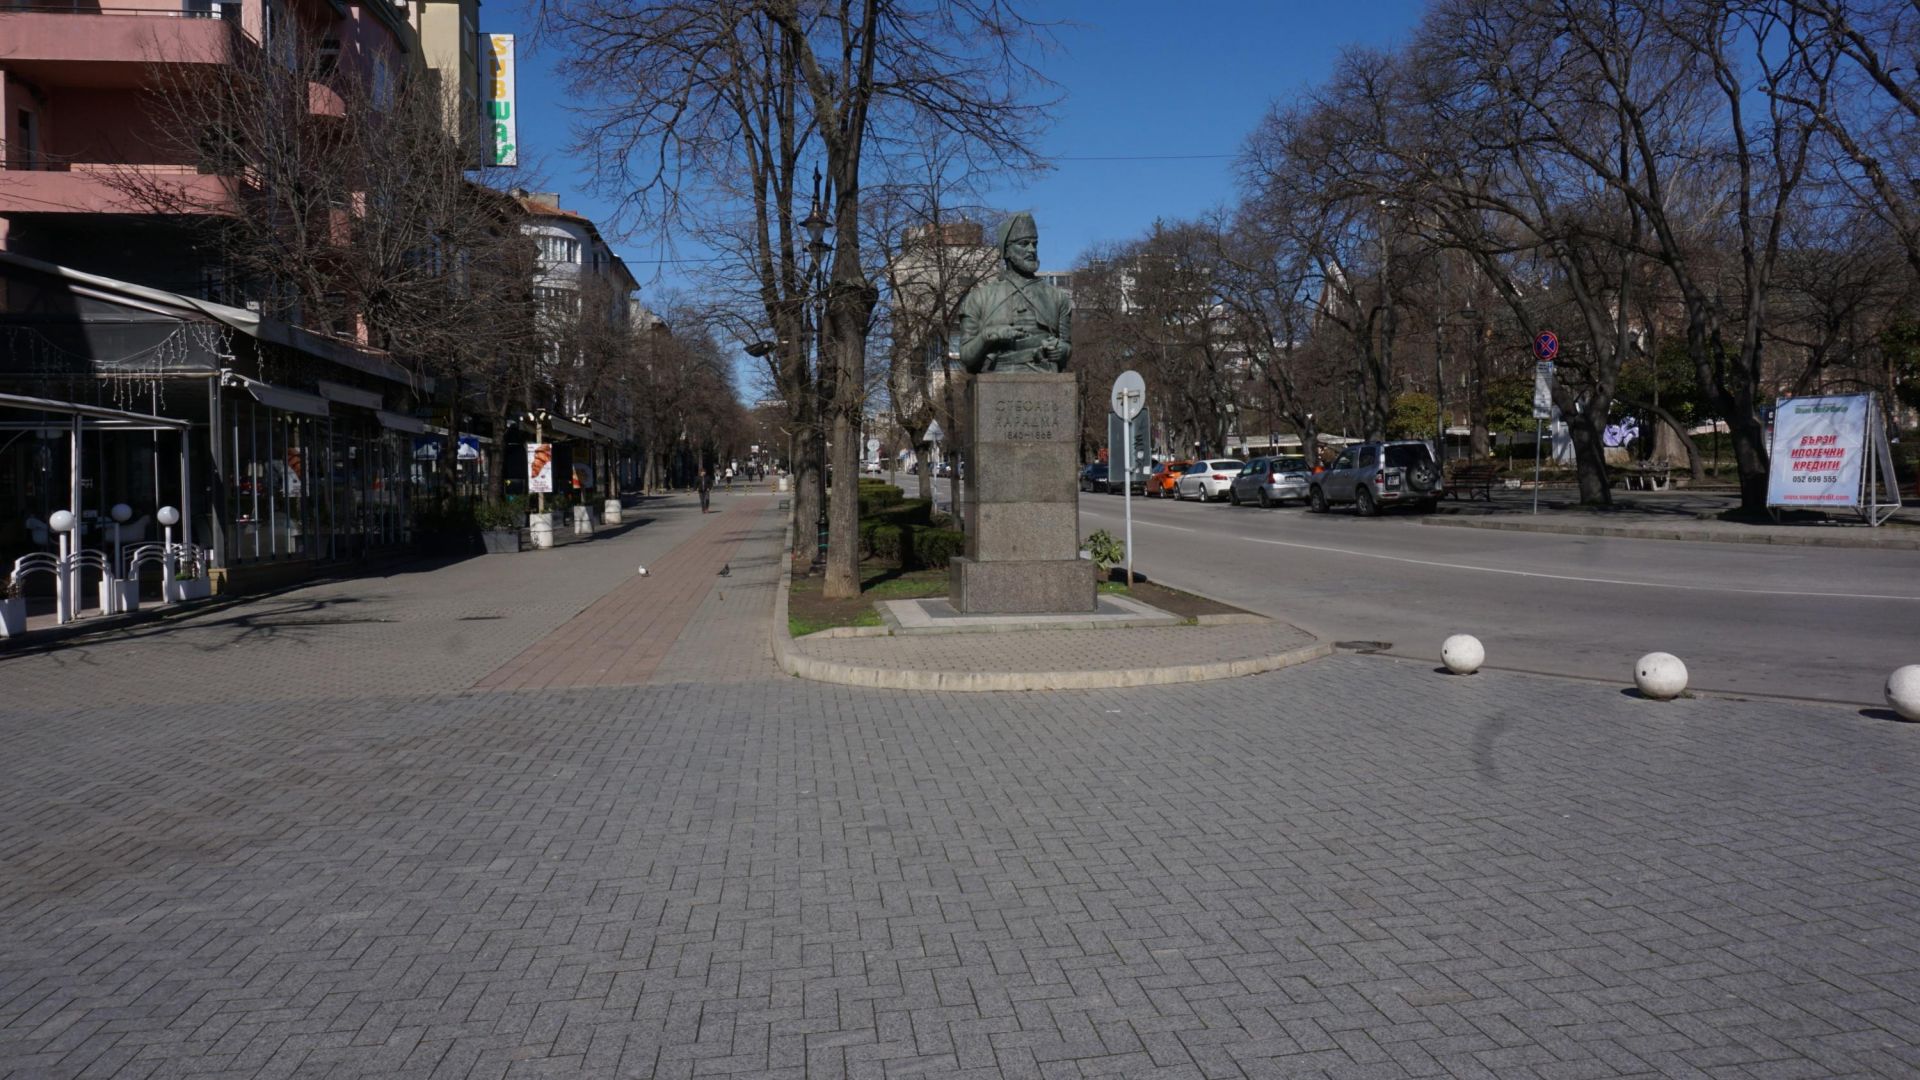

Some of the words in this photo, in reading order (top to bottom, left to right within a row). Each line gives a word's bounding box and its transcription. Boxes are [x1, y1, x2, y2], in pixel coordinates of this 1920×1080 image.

[486, 36, 514, 164] SUBWAY
[1801, 435, 1837, 445] БЪРЗИ
[1791, 447, 1845, 458] ИПОТЕЧНИ
[1793, 461, 1840, 471] КРЕДИТИ
[1792, 475, 1805, 483] 052
[1808, 475, 1821, 483] 699
[1823, 475, 1837, 484] 555
